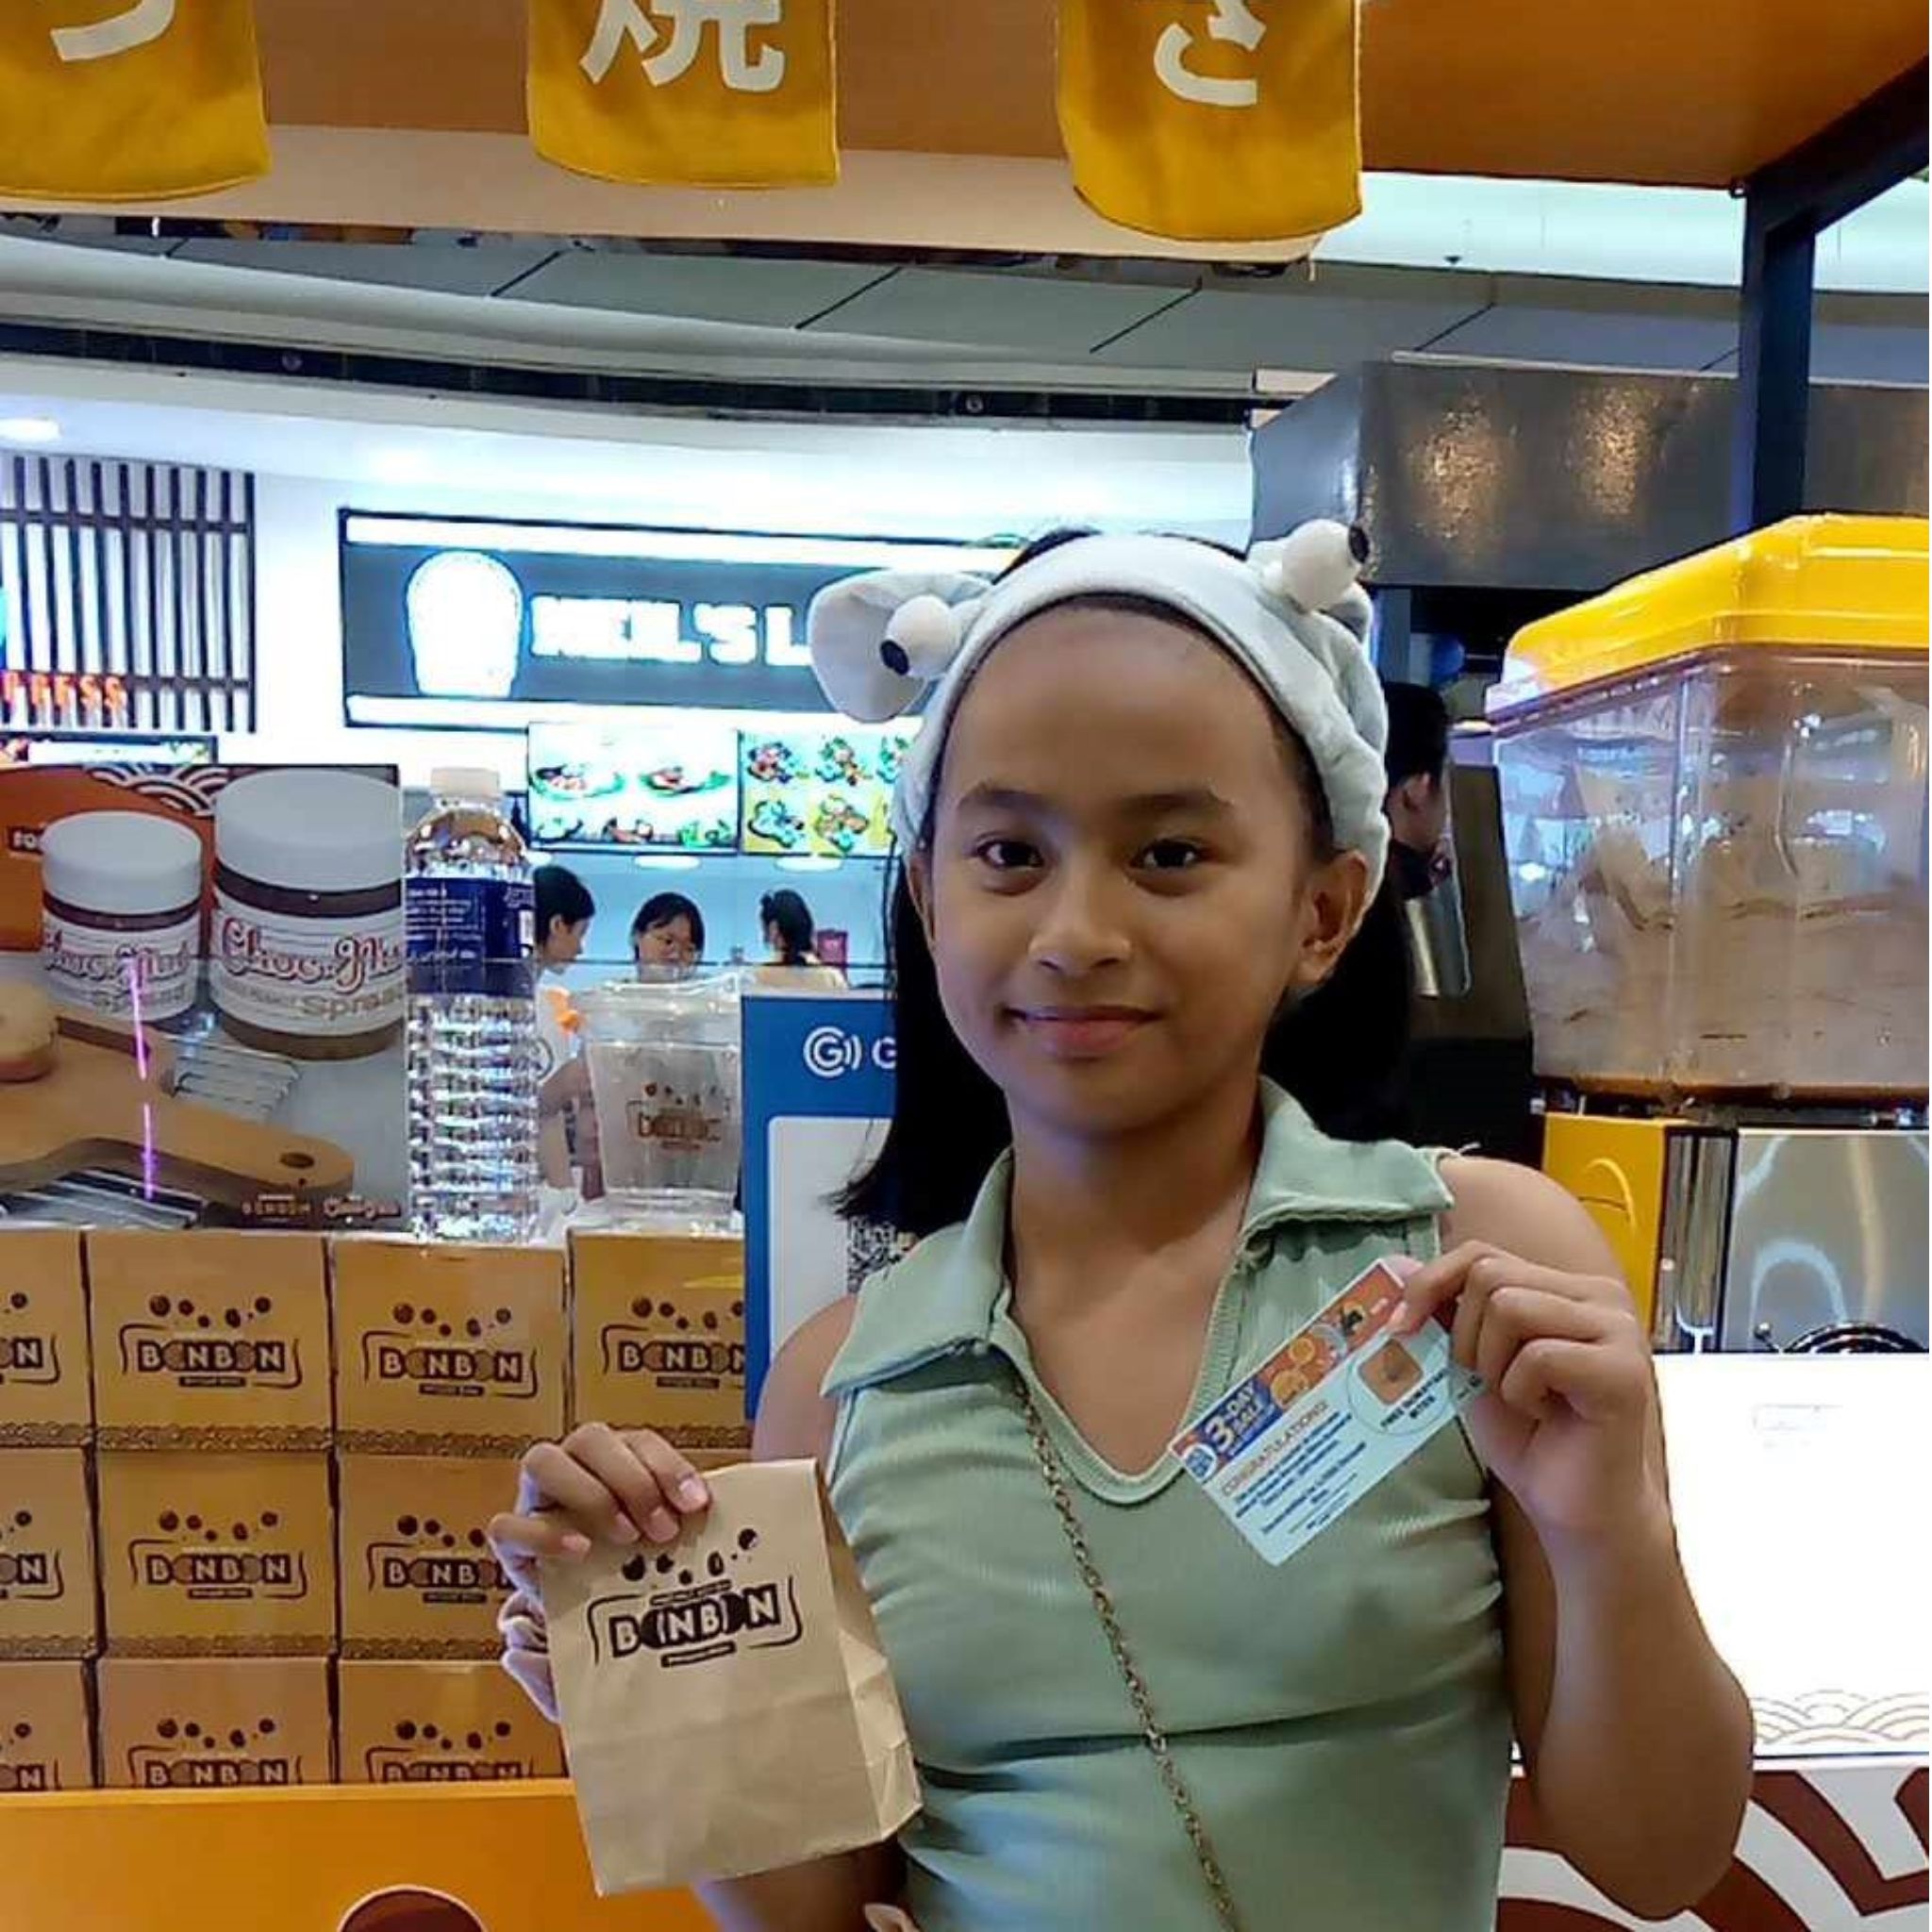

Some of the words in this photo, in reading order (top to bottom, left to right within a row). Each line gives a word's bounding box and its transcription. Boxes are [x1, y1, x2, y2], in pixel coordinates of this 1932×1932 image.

[766, 607, 812, 665] L
[138, 1339, 286, 1373] BONBON
[379, 1346, 523, 1383] BONBON
[383, 1557, 517, 1590] BONBO
